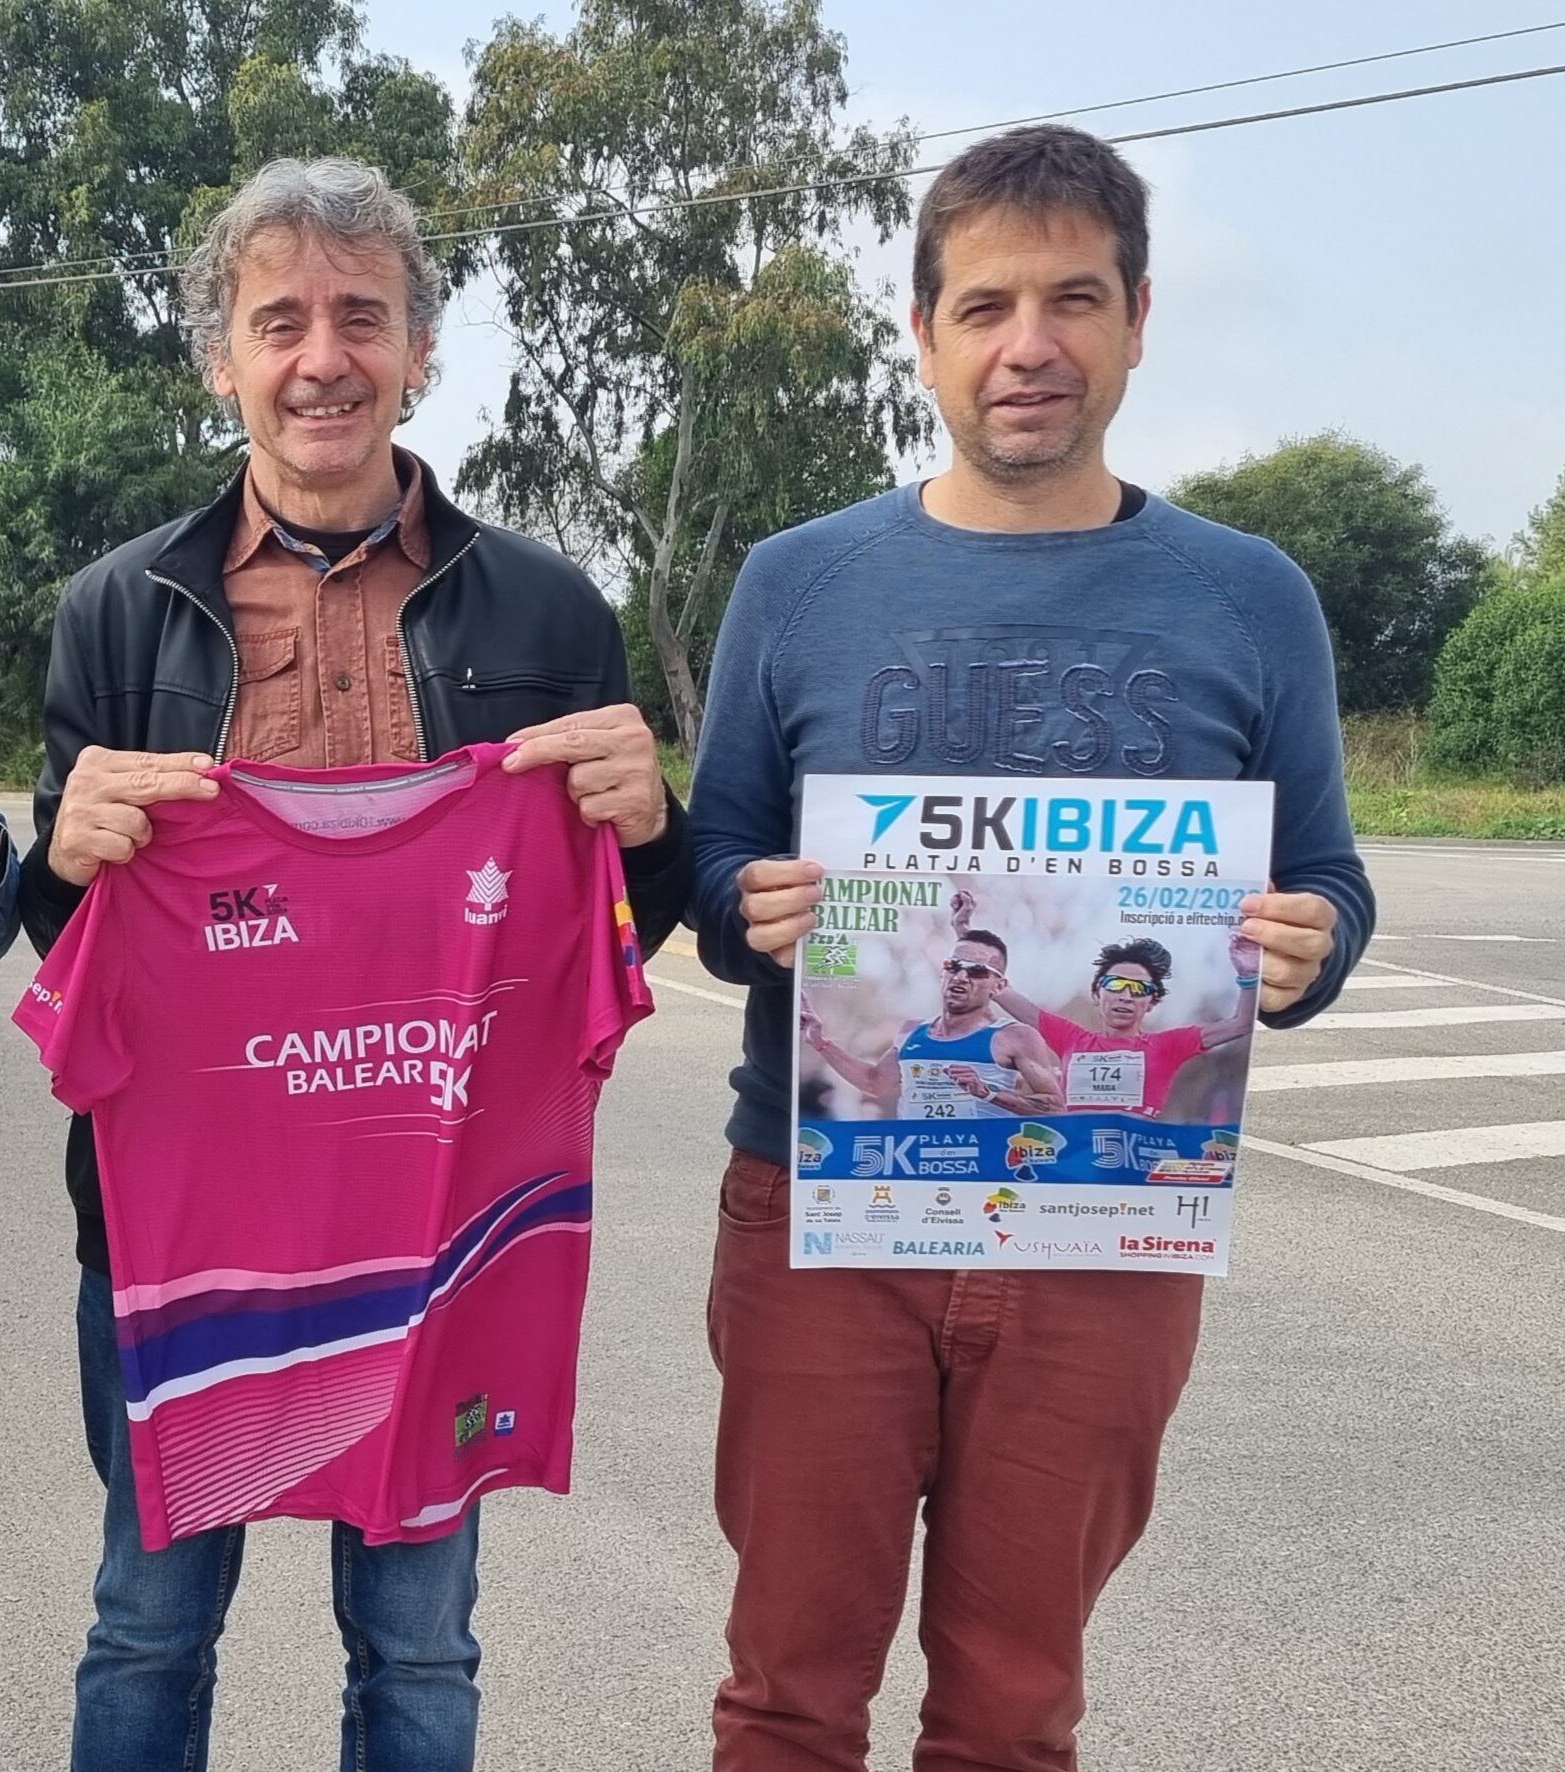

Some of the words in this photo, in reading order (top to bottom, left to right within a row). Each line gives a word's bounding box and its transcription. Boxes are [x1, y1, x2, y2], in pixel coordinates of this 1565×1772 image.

[860, 657, 1179, 776] GUESS
[864, 853, 982, 872] PLATJA
[1006, 856, 1083, 874] D'EN
[1109, 858, 1219, 877] BOSSA
[818, 877, 942, 907] AMPIONAT
[209, 887, 265, 921] 5K
[809, 904, 899, 932] BALEAR
[1120, 910, 1175, 927] Inscripció
[1176, 914, 1184, 925] a
[1186, 911, 1250, 928] elitechip.n
[204, 915, 299, 952] IBIZA
[245, 1010, 498, 1068] CAMPIONAT
[1088, 1066, 1122, 1082] 174
[287, 1059, 423, 1095] BALEAR
[429, 1061, 473, 1112] 5K
[923, 1103, 956, 1119] 242
[919, 1134, 979, 1145] PLAYA
[1091, 1128, 1140, 1171] 5K
[1136, 1134, 1177, 1148] PLAYA
[798, 1151, 822, 1163] iza
[850, 1135, 919, 1177] 5K
[918, 1160, 980, 1175] BOSSA
[921, 1216, 964, 1225] d'Eivissa
[924, 1208, 961, 1216] Consell
[835, 1232, 883, 1244] NASSAU
